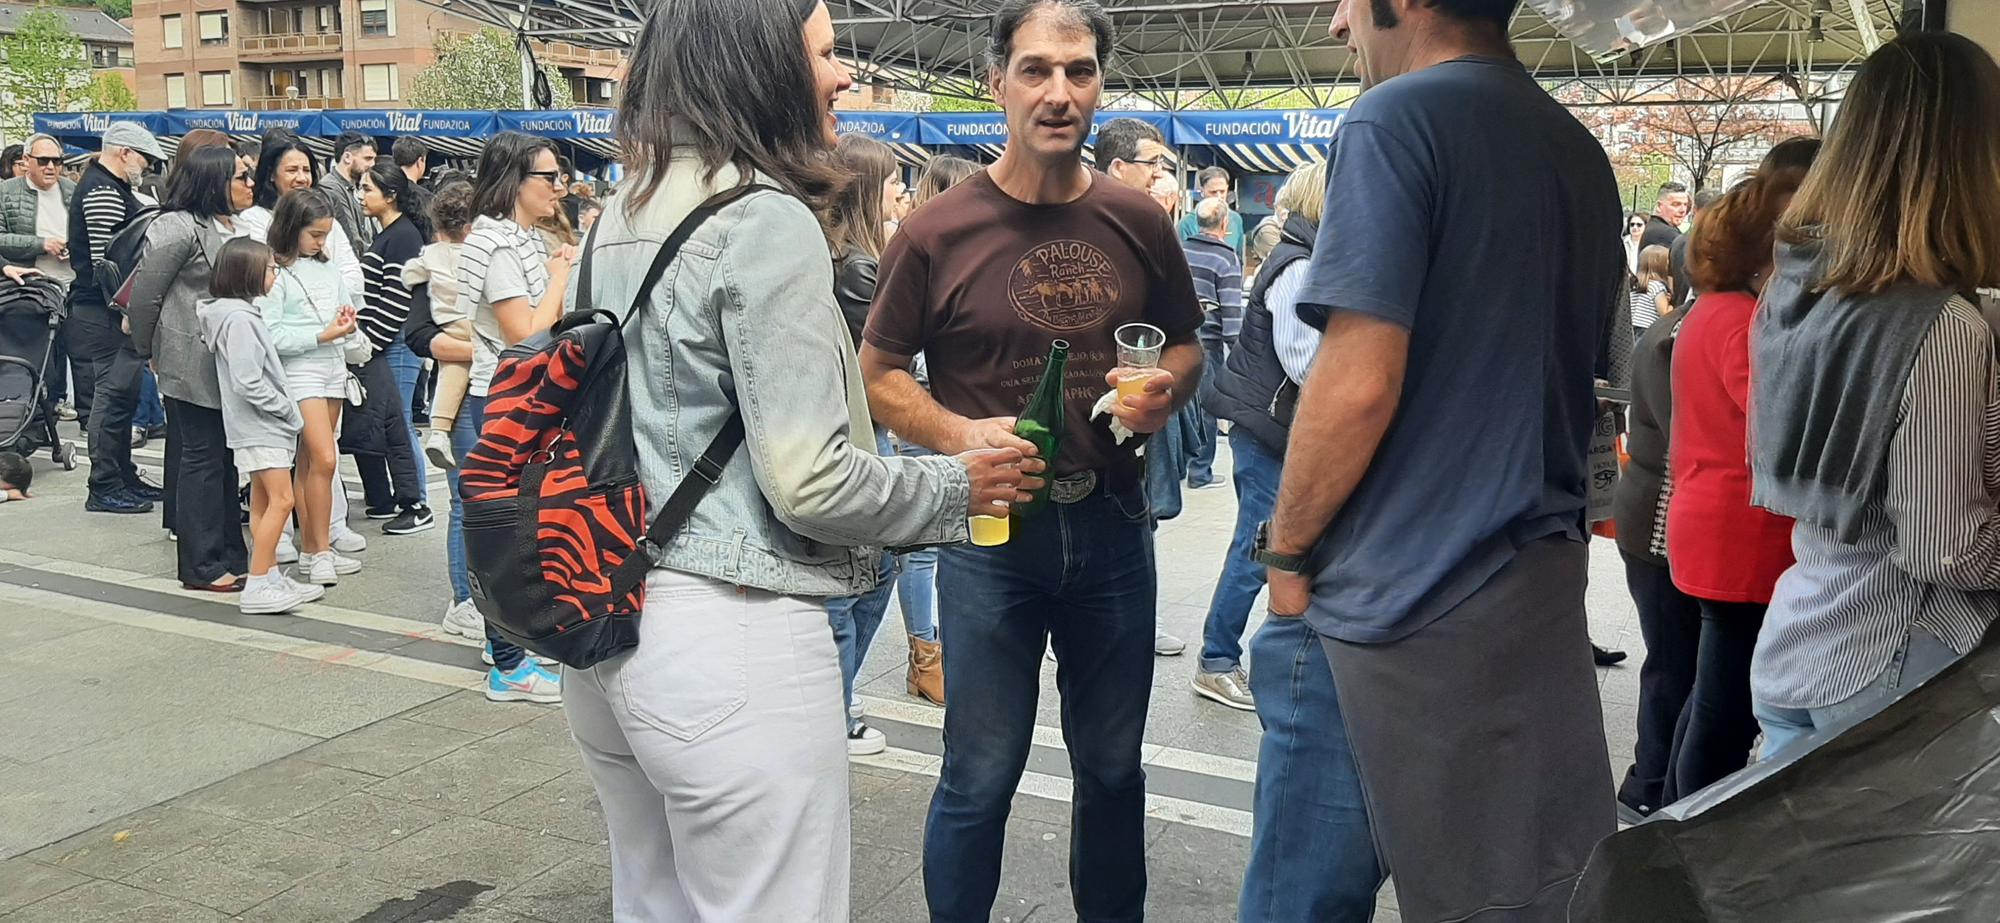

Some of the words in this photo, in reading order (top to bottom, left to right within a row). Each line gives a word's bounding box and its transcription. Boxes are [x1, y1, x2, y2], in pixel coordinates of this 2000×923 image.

[81, 113, 110, 133] Vital
[225, 111, 258, 131] Vital
[341, 118, 386, 129] FUNDACIÓN
[386, 111, 421, 132] Vital
[423, 120, 471, 131] FUNDAZIOA
[520, 119, 573, 131] FUNDACIÓN
[572, 110, 612, 134] Vital
[834, 121, 886, 133] UNDAZIOA
[947, 121, 1009, 136] FUNDACIÓN
[1205, 121, 1281, 136] FUNDACIÓN
[1283, 112, 1344, 139] Vital
[1035, 242, 1112, 275] PALOUSE
